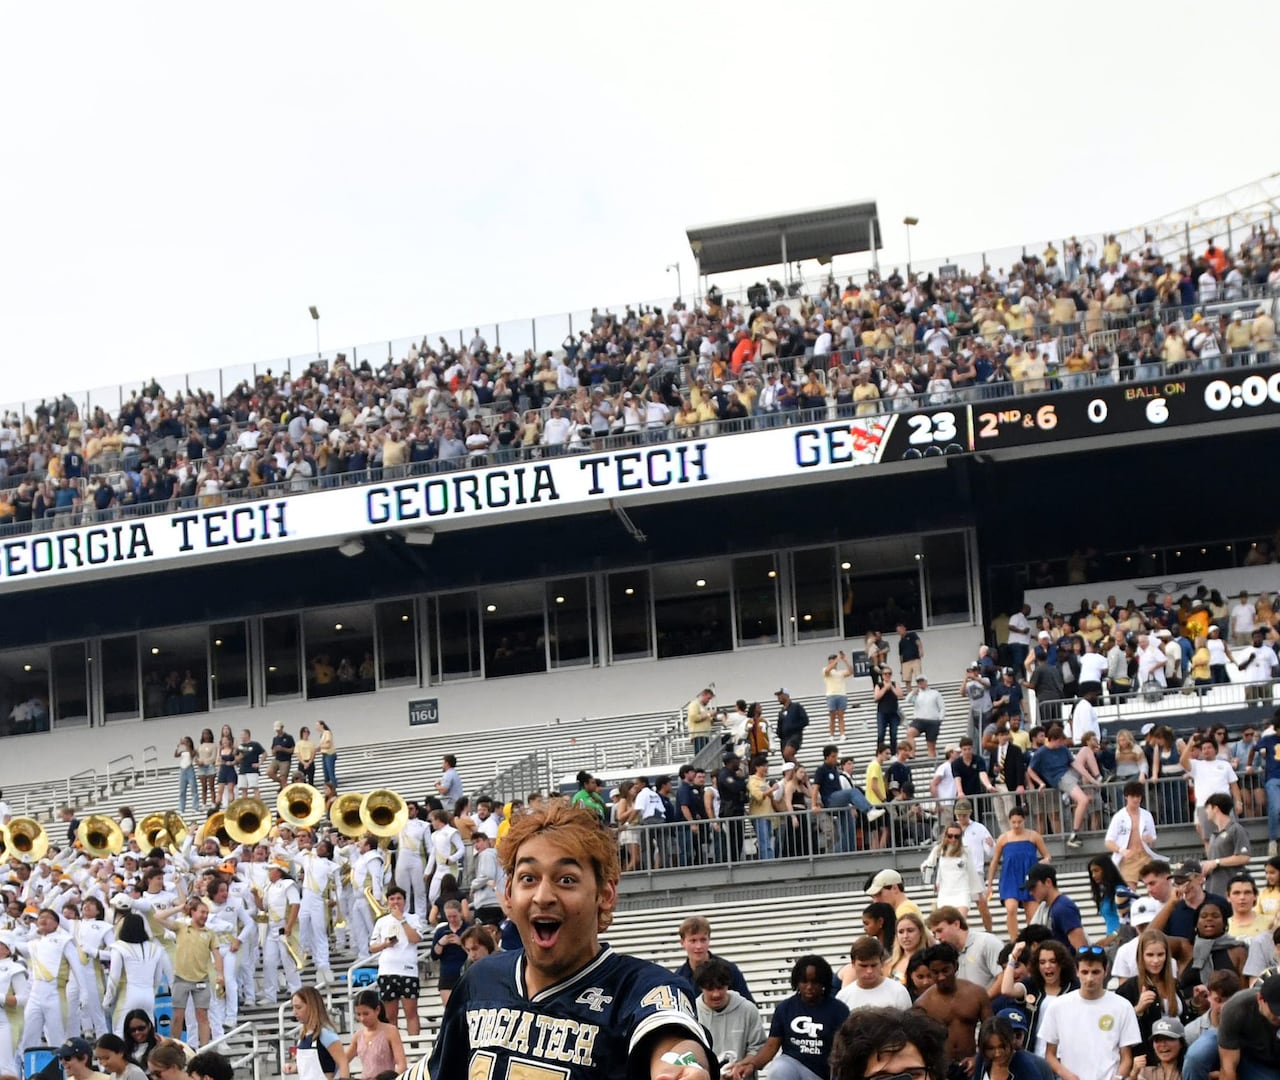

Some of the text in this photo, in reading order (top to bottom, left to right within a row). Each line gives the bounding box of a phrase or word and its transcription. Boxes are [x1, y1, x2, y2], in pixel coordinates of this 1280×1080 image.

[1126, 382, 1186, 401] BALL ON
[1022, 413, 1035, 428] &
[1036, 405, 1058, 430] 6
[1087, 399, 1108, 424] 0
[1145, 398, 1169, 424] 6
[907, 412, 958, 445] 23
[366, 442, 709, 526] GEORGIA TECH
[170, 500, 289, 552] TECH
[410, 708, 438, 722] 116U
[790, 1016, 823, 1038] GT
[790, 1037, 823, 1047] Georgia
